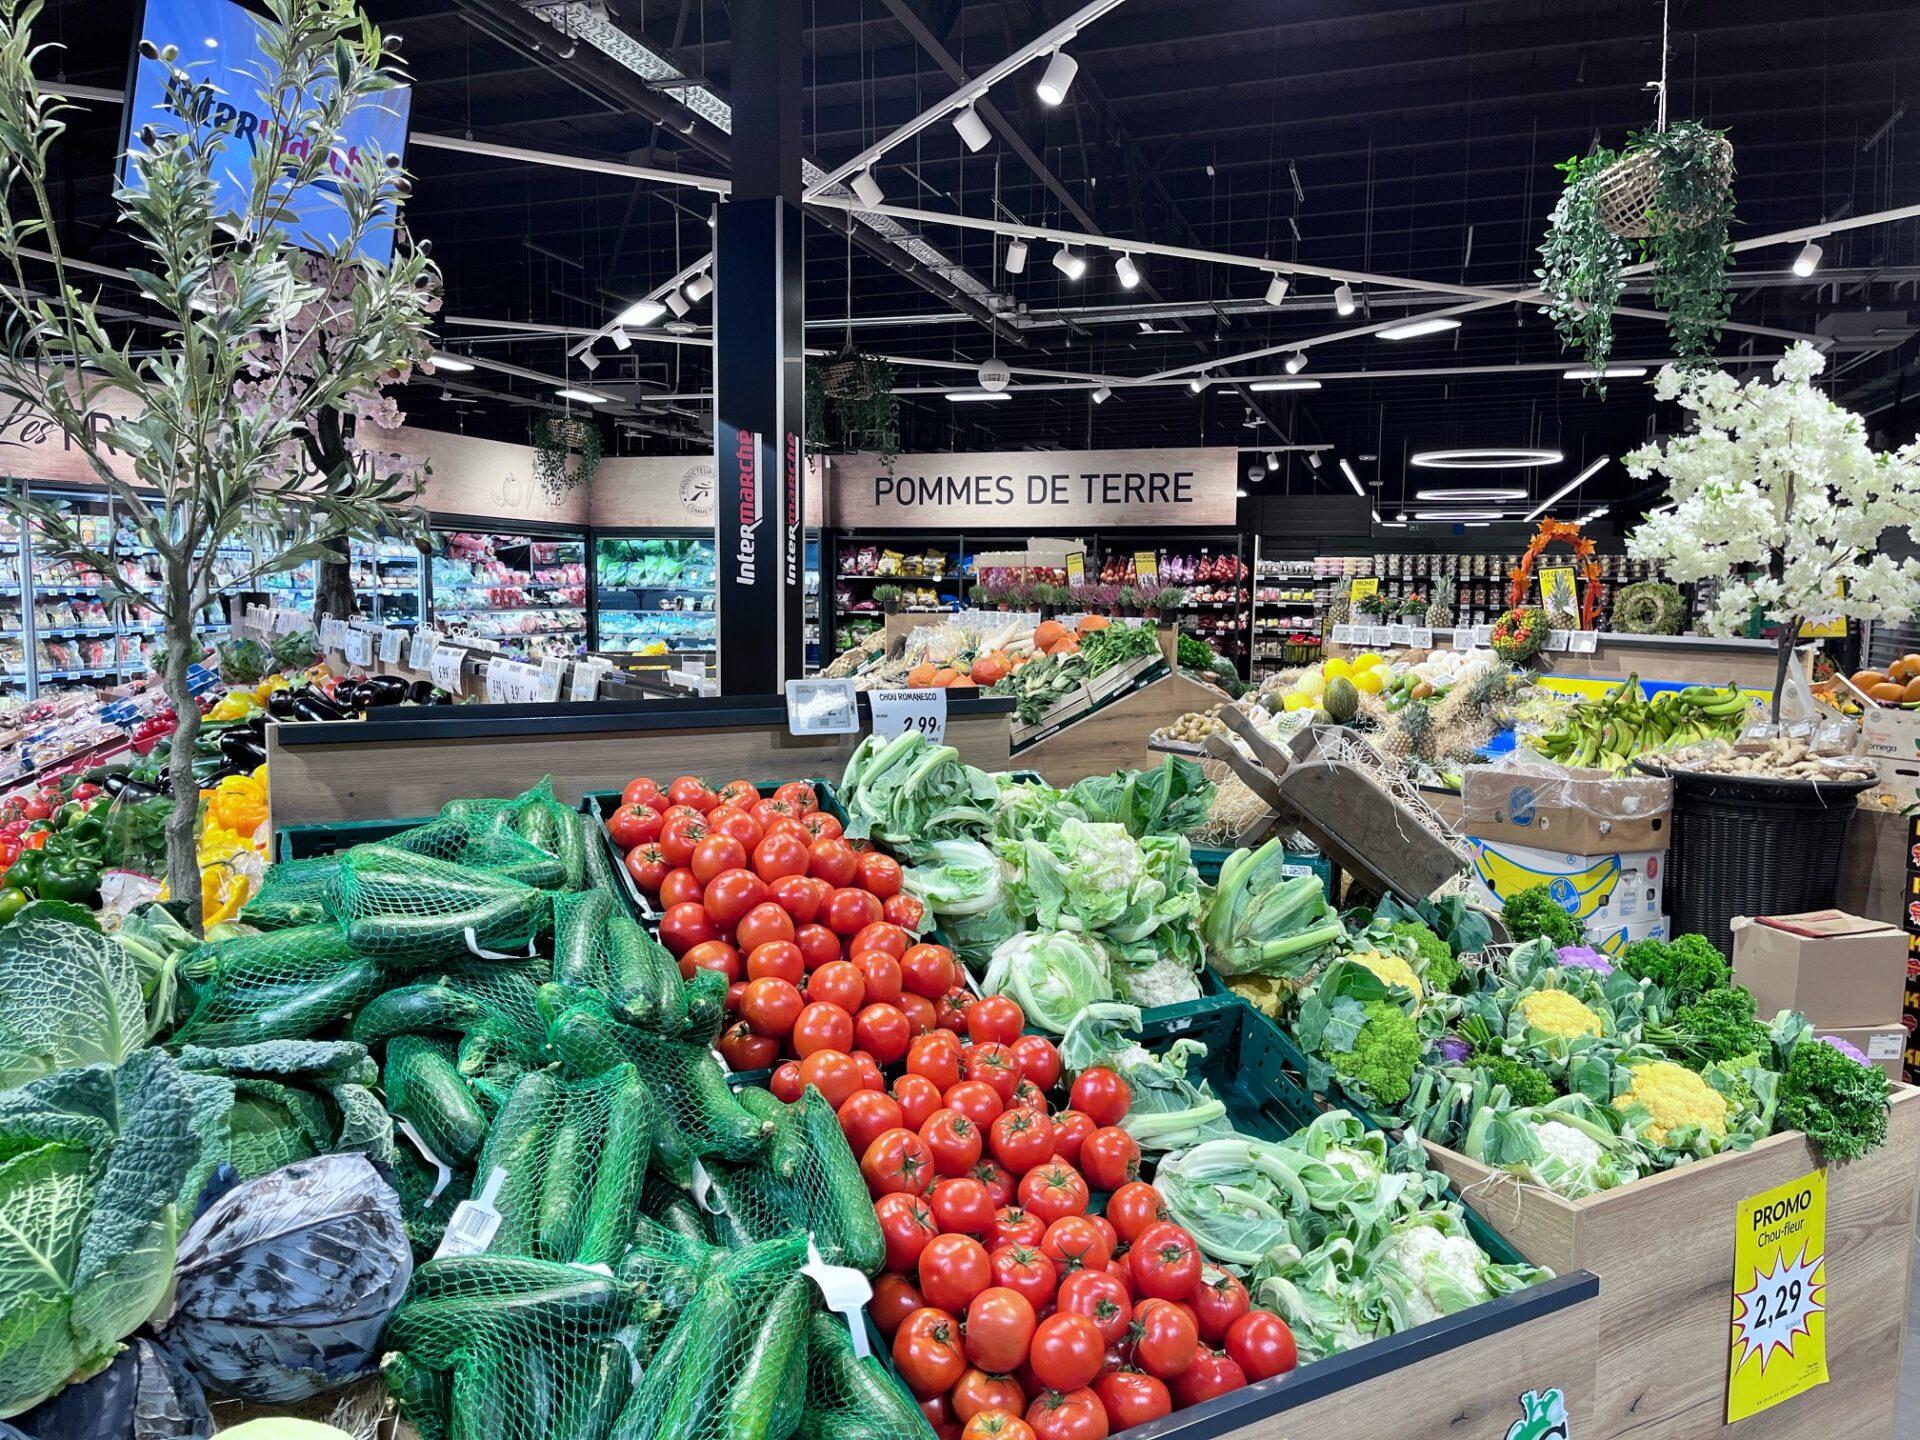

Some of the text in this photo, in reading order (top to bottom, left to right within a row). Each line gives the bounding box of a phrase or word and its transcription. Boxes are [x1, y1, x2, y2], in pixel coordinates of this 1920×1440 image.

[875, 471, 1194, 506] POMMES DE TERRE
[879, 692, 937, 701] CHOU ROMANESCO
[1753, 1189, 1812, 1232] PROMO
[1758, 1219, 1805, 1248] Chou-fleur
[1754, 1279, 1801, 1329] 2,29
